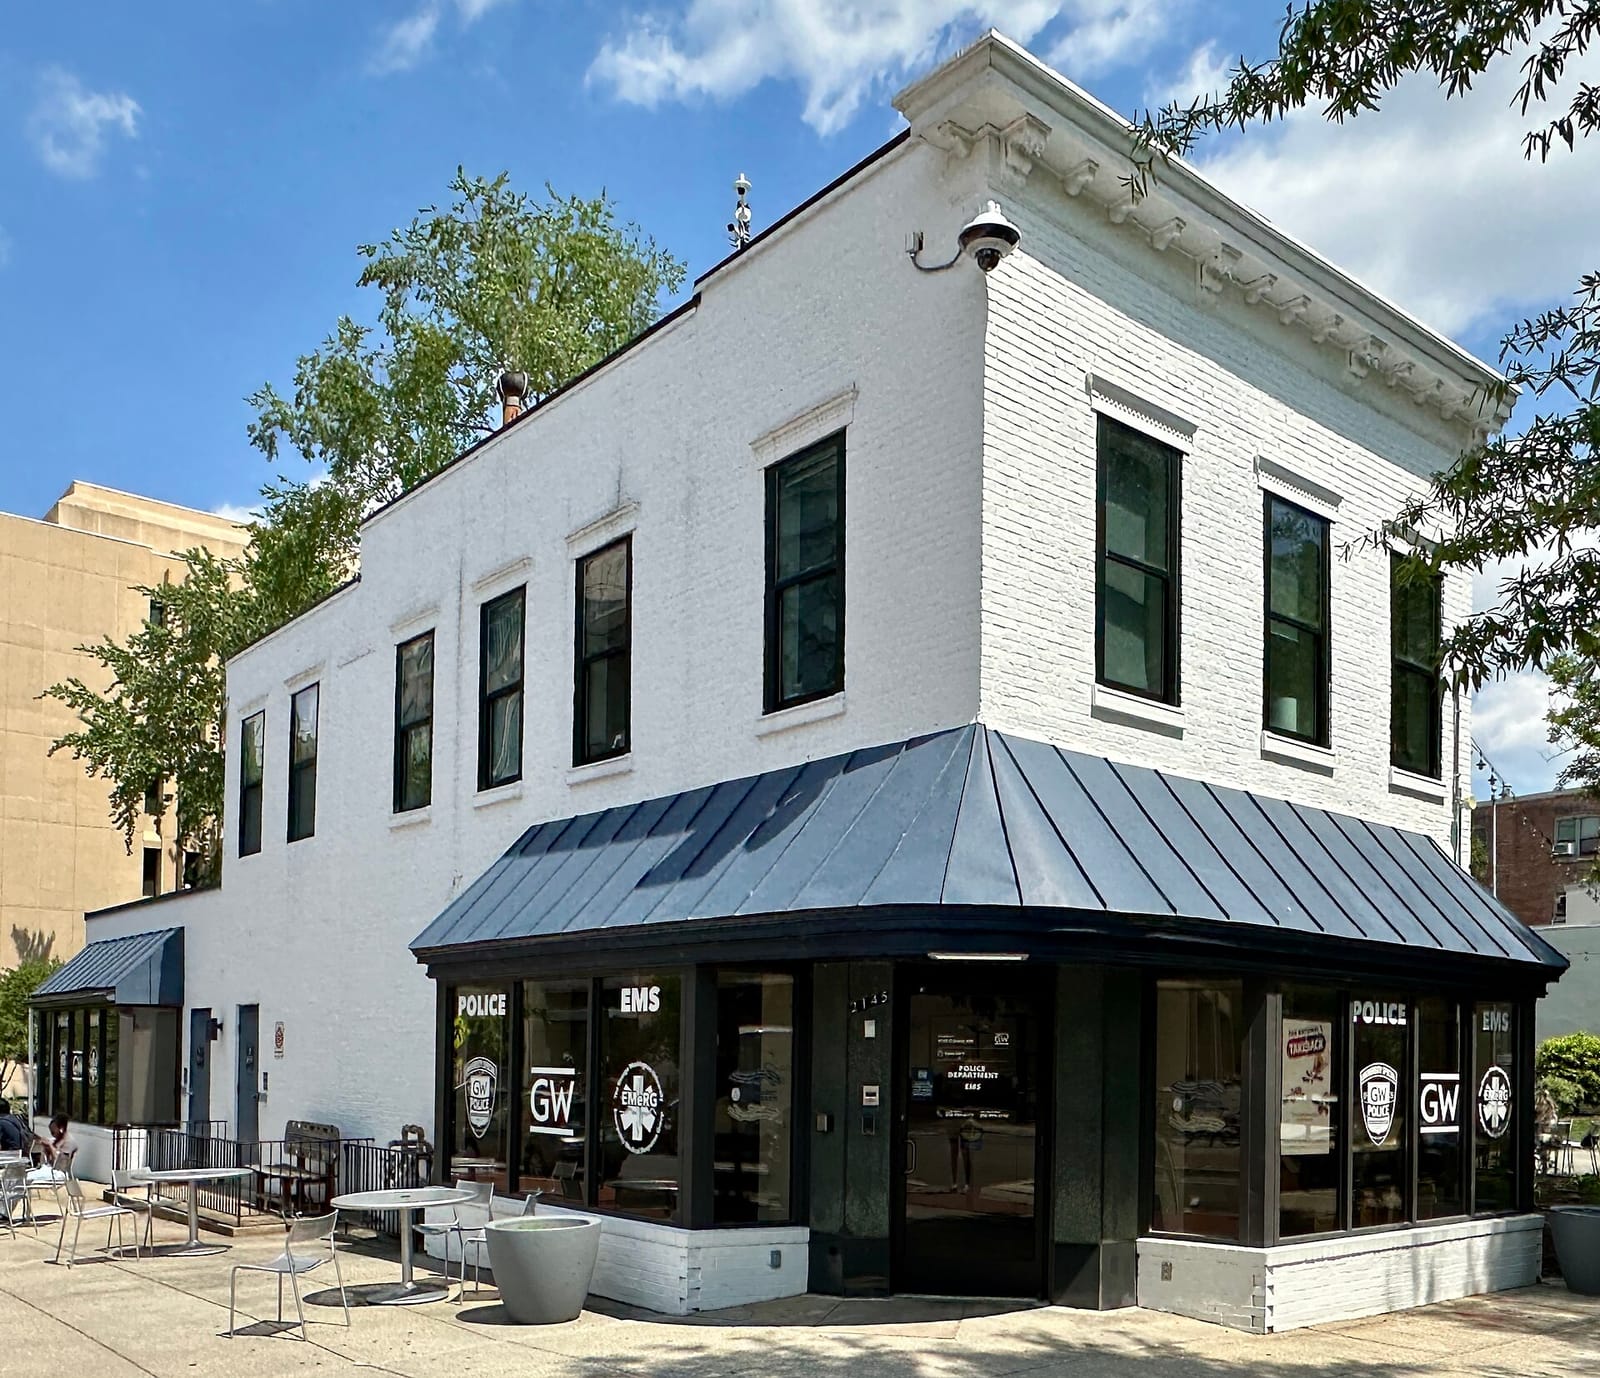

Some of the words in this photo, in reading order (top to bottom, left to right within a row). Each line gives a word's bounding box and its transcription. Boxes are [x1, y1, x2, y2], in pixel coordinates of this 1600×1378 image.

[458, 993, 506, 1016] POLICE
[620, 986, 660, 1012] EMS
[1353, 1001, 1407, 1025] POLICE
[1482, 1010, 1509, 1032] EMS
[947, 1071, 999, 1079] DEPARTMENT
[473, 1080, 487, 1096] GW
[1370, 1087, 1387, 1102] GW
[530, 1078, 575, 1123] GW
[1367, 1105, 1389, 1117] POLICE
[1420, 1083, 1460, 1123] GW
